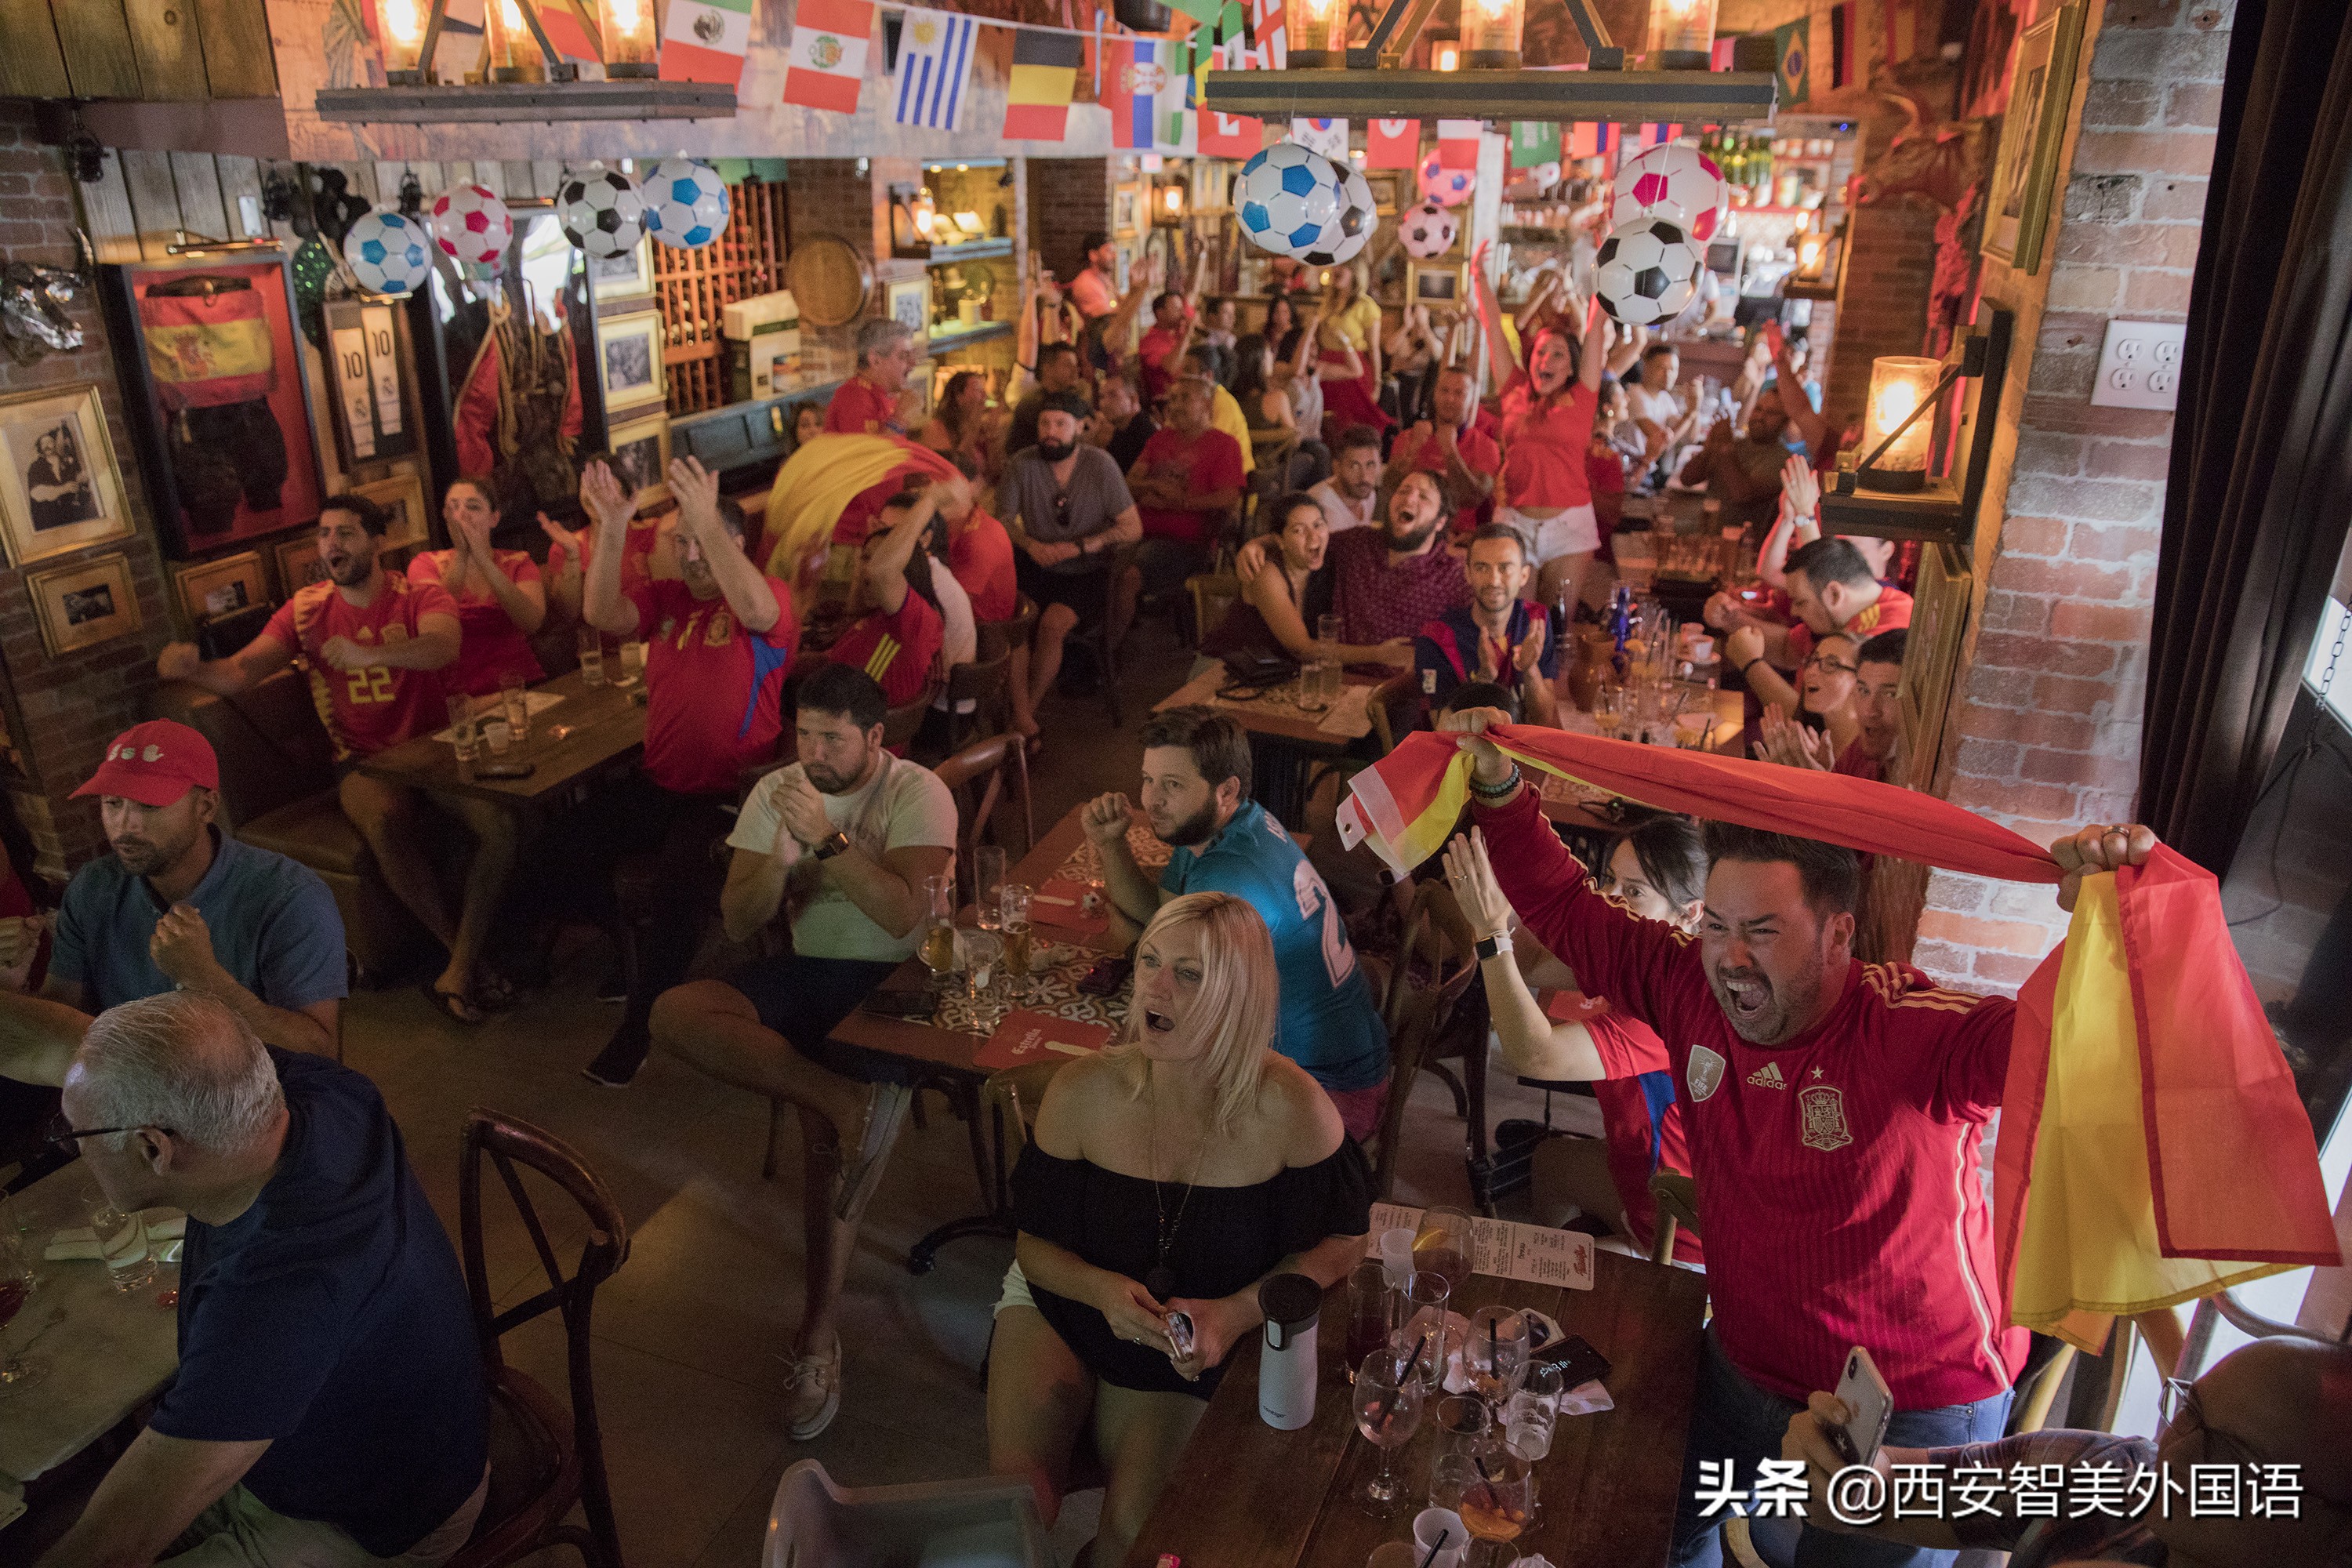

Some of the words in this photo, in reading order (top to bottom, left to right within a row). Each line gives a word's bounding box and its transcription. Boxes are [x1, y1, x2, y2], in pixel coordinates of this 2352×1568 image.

[372, 329, 391, 358] 10
[343, 350, 364, 379] 10
[347, 666, 397, 703] 22
[1693, 1078, 1708, 1092] FIFA
[1746, 1076, 1788, 1091] adidas
